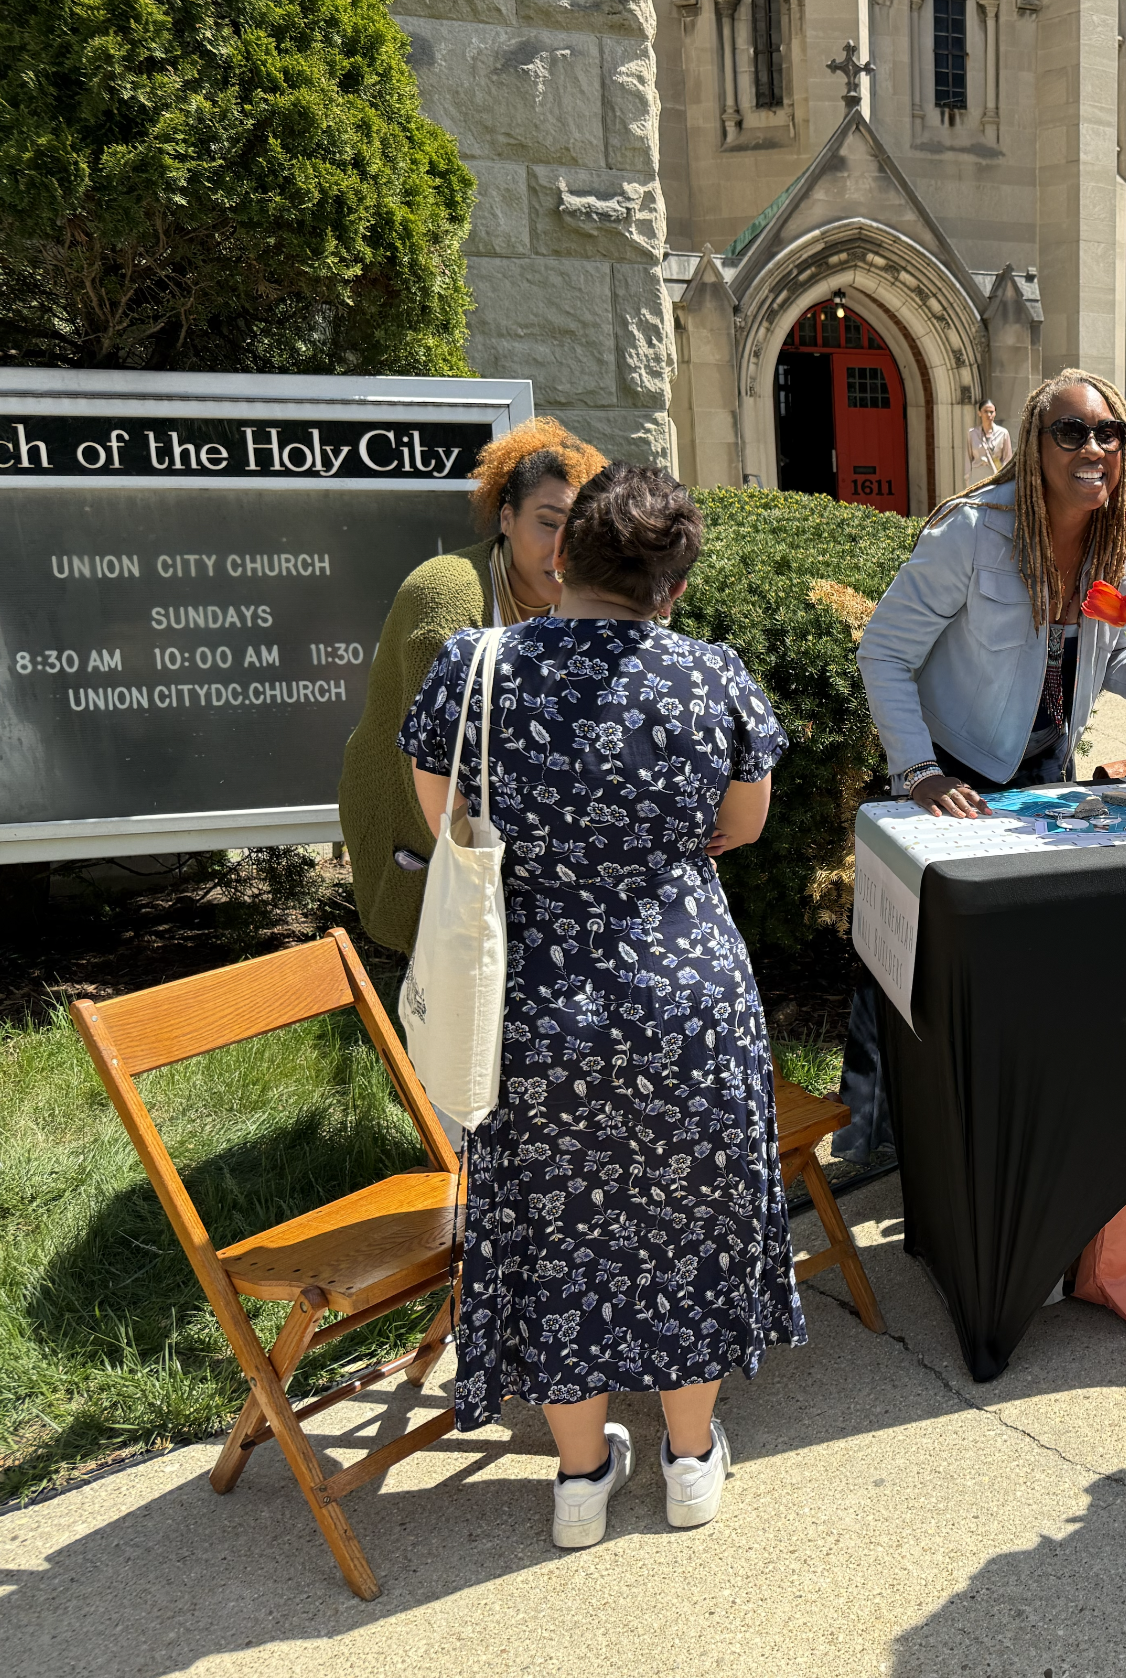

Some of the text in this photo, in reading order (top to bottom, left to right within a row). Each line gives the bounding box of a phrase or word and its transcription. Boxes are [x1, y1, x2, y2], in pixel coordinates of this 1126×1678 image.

[76, 429, 129, 469] of
[145, 430, 229, 470] the
[241, 427, 352, 477] Holy
[359, 430, 463, 479] City
[851, 479, 895, 496] 1611
[52, 553, 331, 579] UNION CITY CHURCH
[151, 605, 273, 630] SUNDAYS
[15, 649, 79, 674] 8:30
[87, 648, 122, 672] AM
[154, 646, 233, 670] 10:00
[244, 644, 280, 668] AM
[309, 642, 364, 665] 11:30
[855, 865, 877, 910] OJECT
